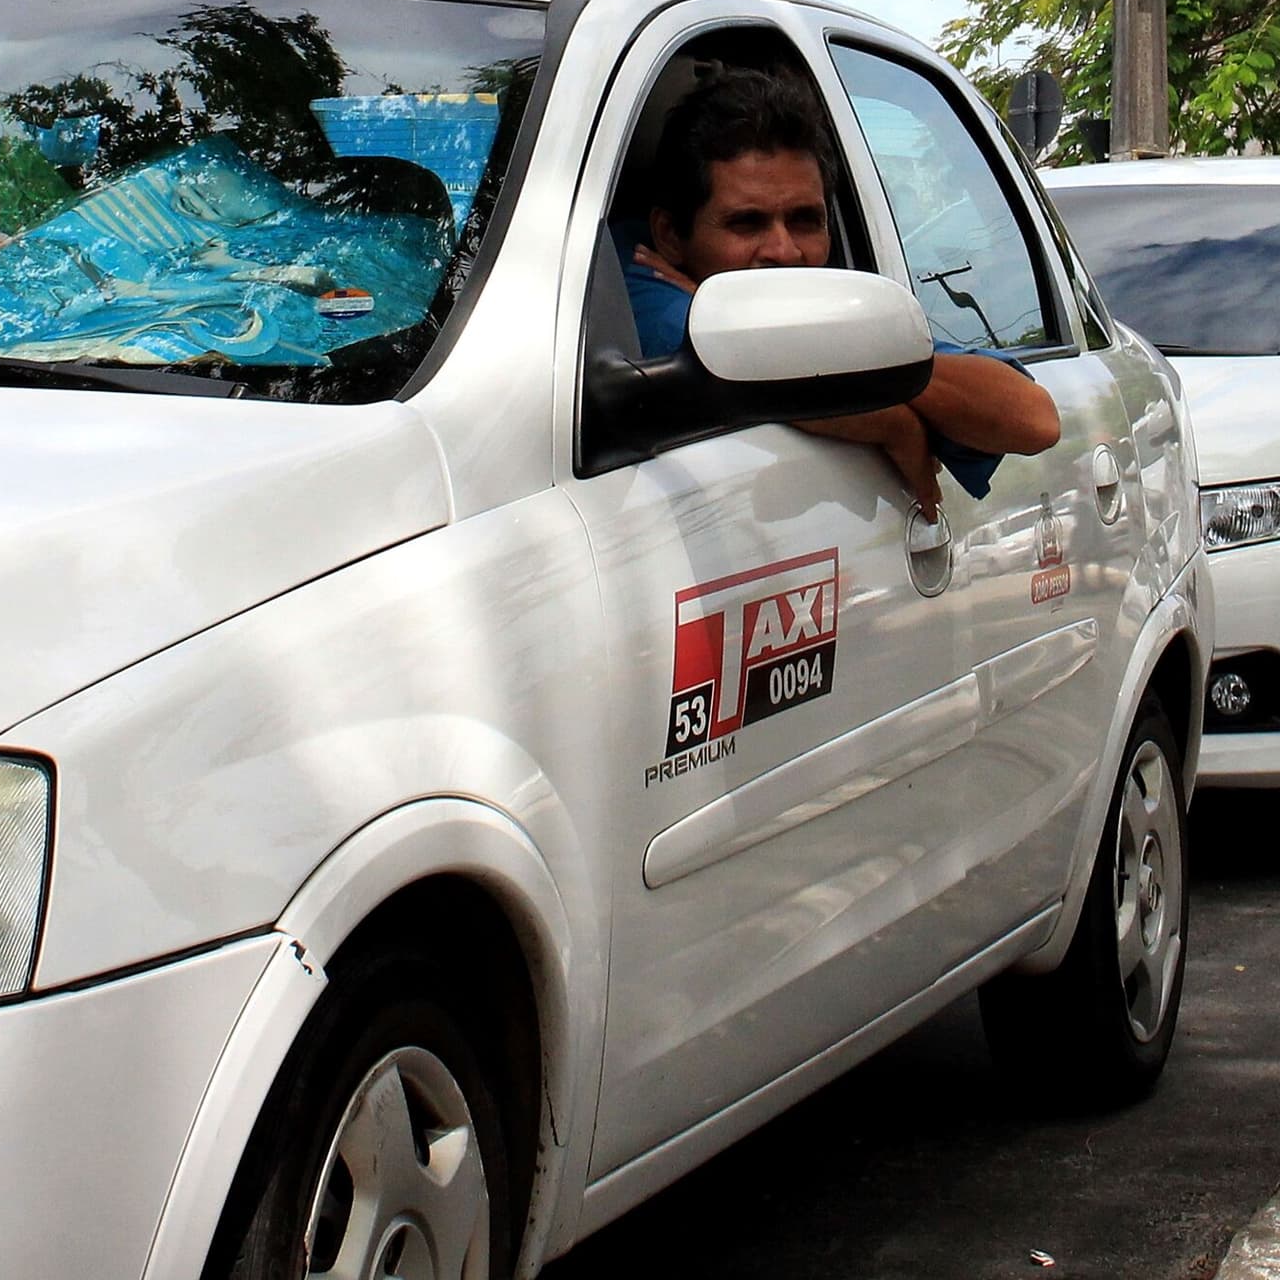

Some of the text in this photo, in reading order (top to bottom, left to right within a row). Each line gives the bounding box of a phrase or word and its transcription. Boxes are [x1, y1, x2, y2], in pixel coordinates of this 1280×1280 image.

[678, 558, 835, 723] TAXI
[769, 653, 823, 705] 0094
[674, 695, 706, 743] 53
[644, 736, 737, 788] PREMIUM
